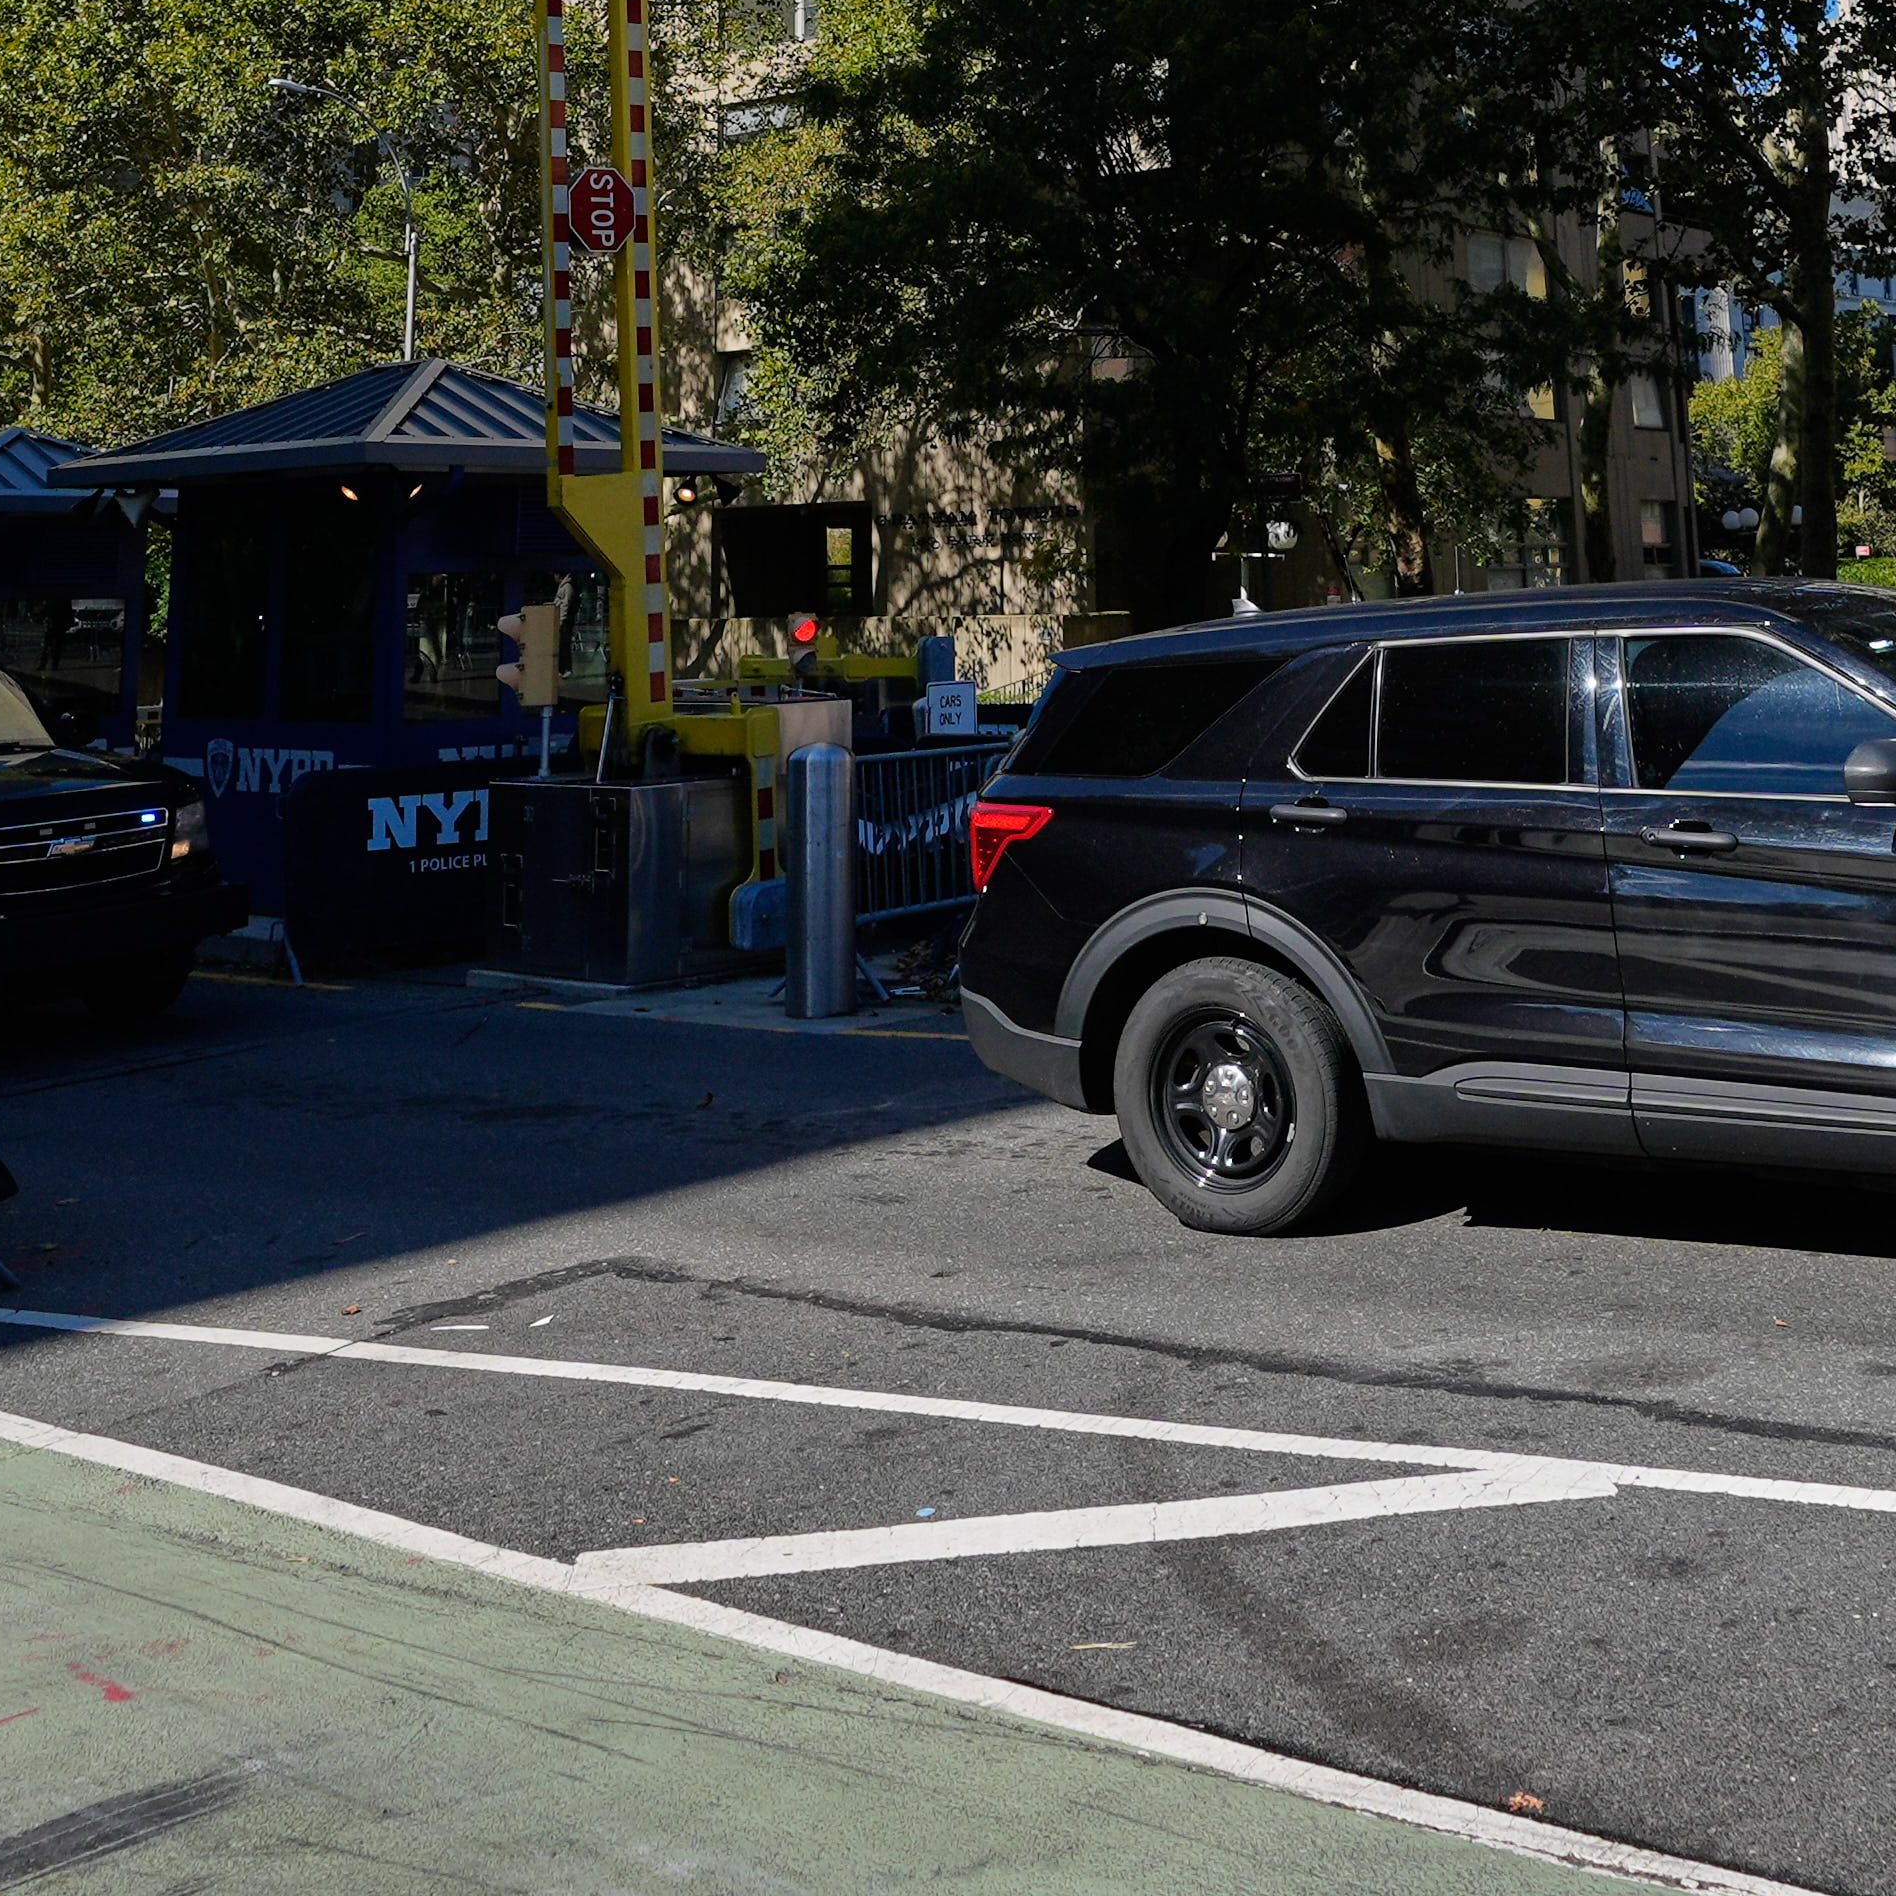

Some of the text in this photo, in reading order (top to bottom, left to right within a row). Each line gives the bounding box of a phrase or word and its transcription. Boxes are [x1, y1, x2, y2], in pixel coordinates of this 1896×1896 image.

[590, 173, 615, 247] STOP
[940, 696, 962, 709] CARS
[939, 713, 962, 726] ONLY
[409, 860, 417, 875] 1
[421, 855, 470, 873] POLICE
